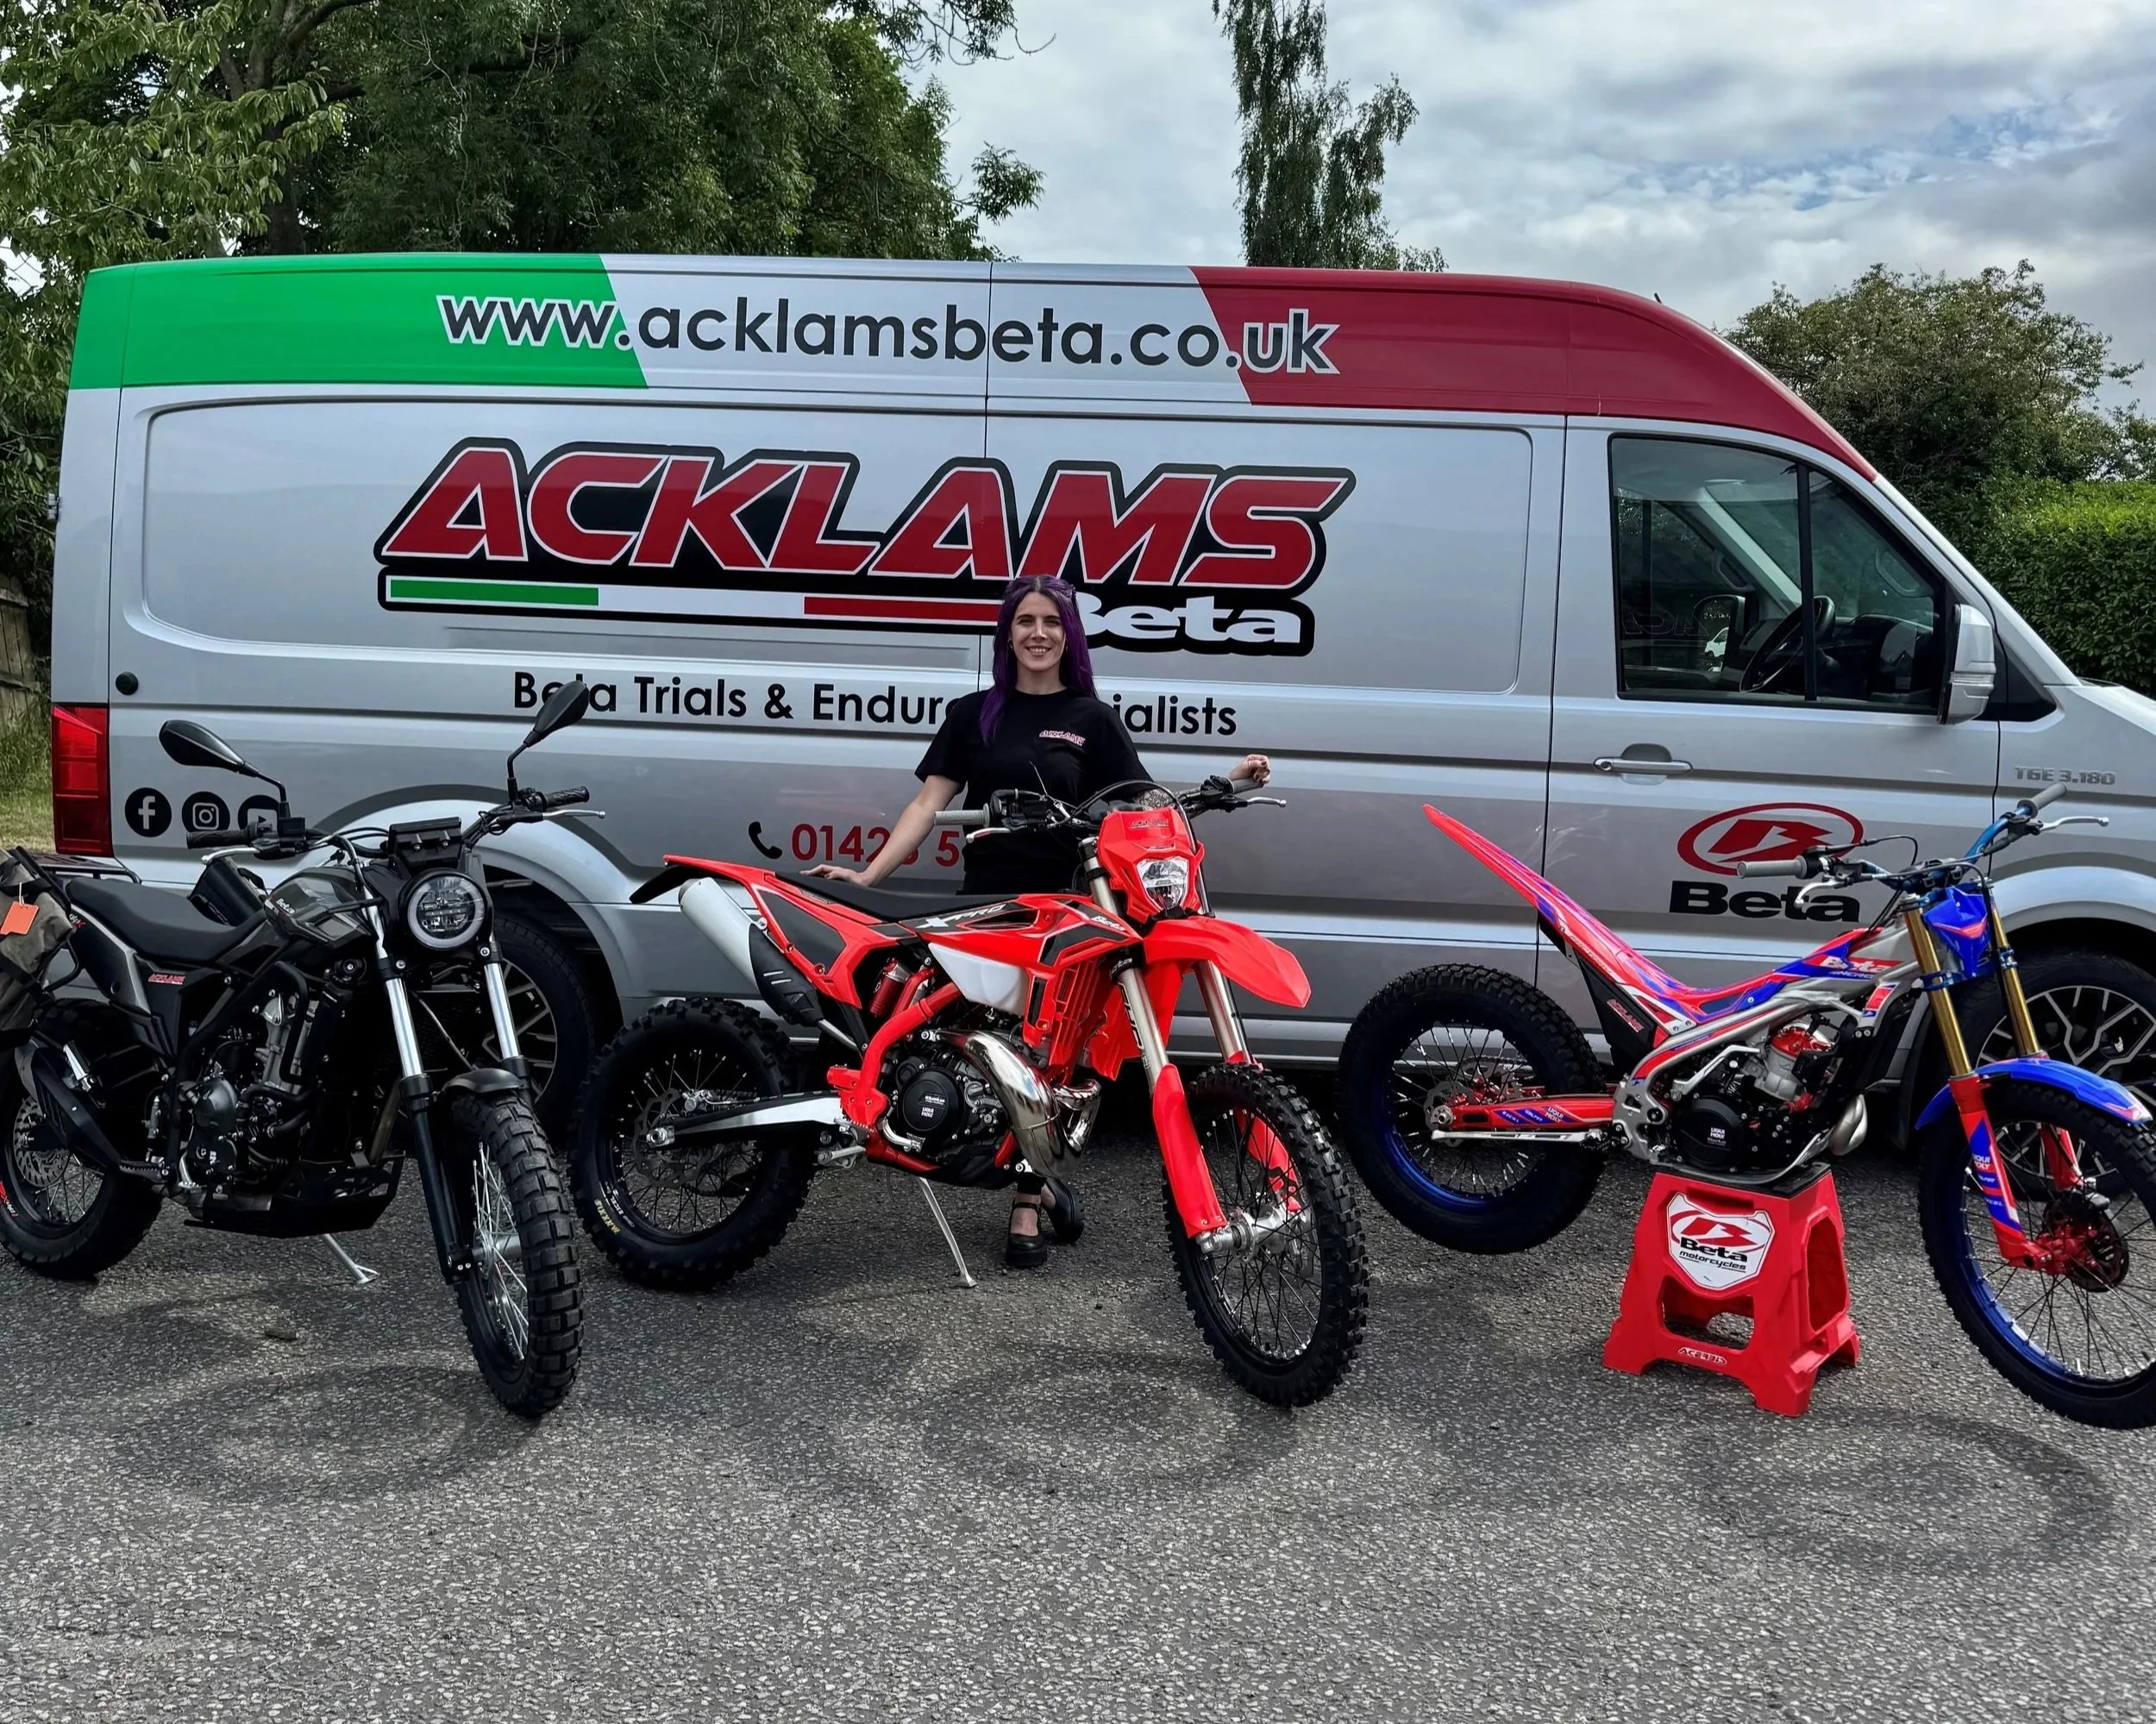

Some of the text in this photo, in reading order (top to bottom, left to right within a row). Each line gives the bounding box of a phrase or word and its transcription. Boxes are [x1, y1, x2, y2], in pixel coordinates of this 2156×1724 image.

[437, 293, 1339, 377] www.acklamsbeta.co.uk
[378, 442, 1351, 592] ACKLAMS
[634, 675, 747, 718] Trials
[764, 683, 794, 719] &
[813, 683, 962, 725] Endur
[2015, 765, 2115, 786] TGE 3.180
[792, 824, 919, 866] 0142
[1669, 880, 1860, 923] Beta
[1679, 1250, 1747, 1271] motorcycles
[1680, 1236, 1748, 1263] Beta
